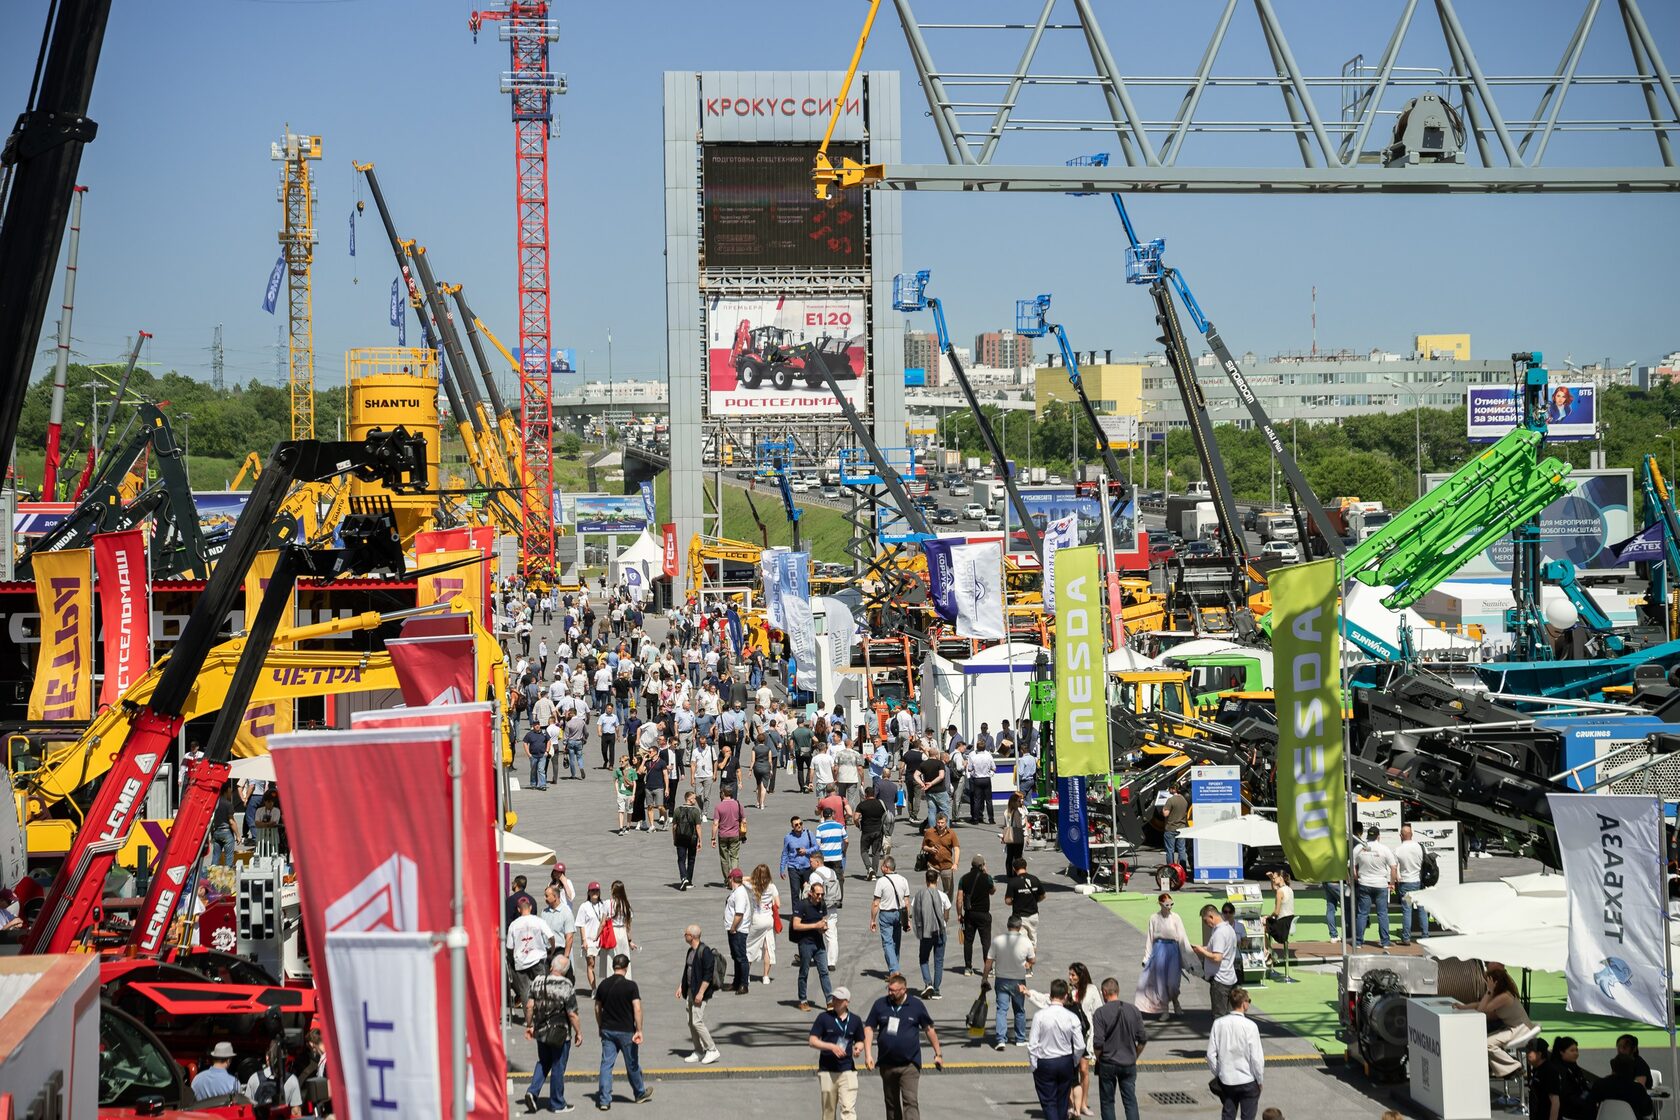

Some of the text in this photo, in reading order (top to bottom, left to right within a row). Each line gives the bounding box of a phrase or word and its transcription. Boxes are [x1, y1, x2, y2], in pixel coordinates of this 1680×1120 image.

[707, 97, 796, 117] КРОКУС
[712, 156, 755, 164] ПОДГОТОВКА
[756, 156, 805, 164] СПЕЦТЕХНИКИ
[1225, 360, 1255, 404] SINOBOOM
[365, 399, 420, 408] SHANTUI
[1487, 412, 1525, 424] эквайр
[1554, 517, 1601, 526] МЕРОПРИЯТИЙ
[1567, 526, 1602, 534] МАСШТАБА
[49, 528, 78, 553] UNDAI
[787, 557, 799, 597] BOOM
[115, 550, 132, 699] СТСЕЛЬМАШ
[1350, 630, 1391, 657] SUNWARD
[1066, 575, 1095, 743] MESDA
[273, 664, 363, 686] ЧЕТРА
[1291, 605, 1330, 842] MESDA
[1575, 730, 1611, 738] CRUKINGS
[1408, 1025, 1440, 1057] YONGMAO
